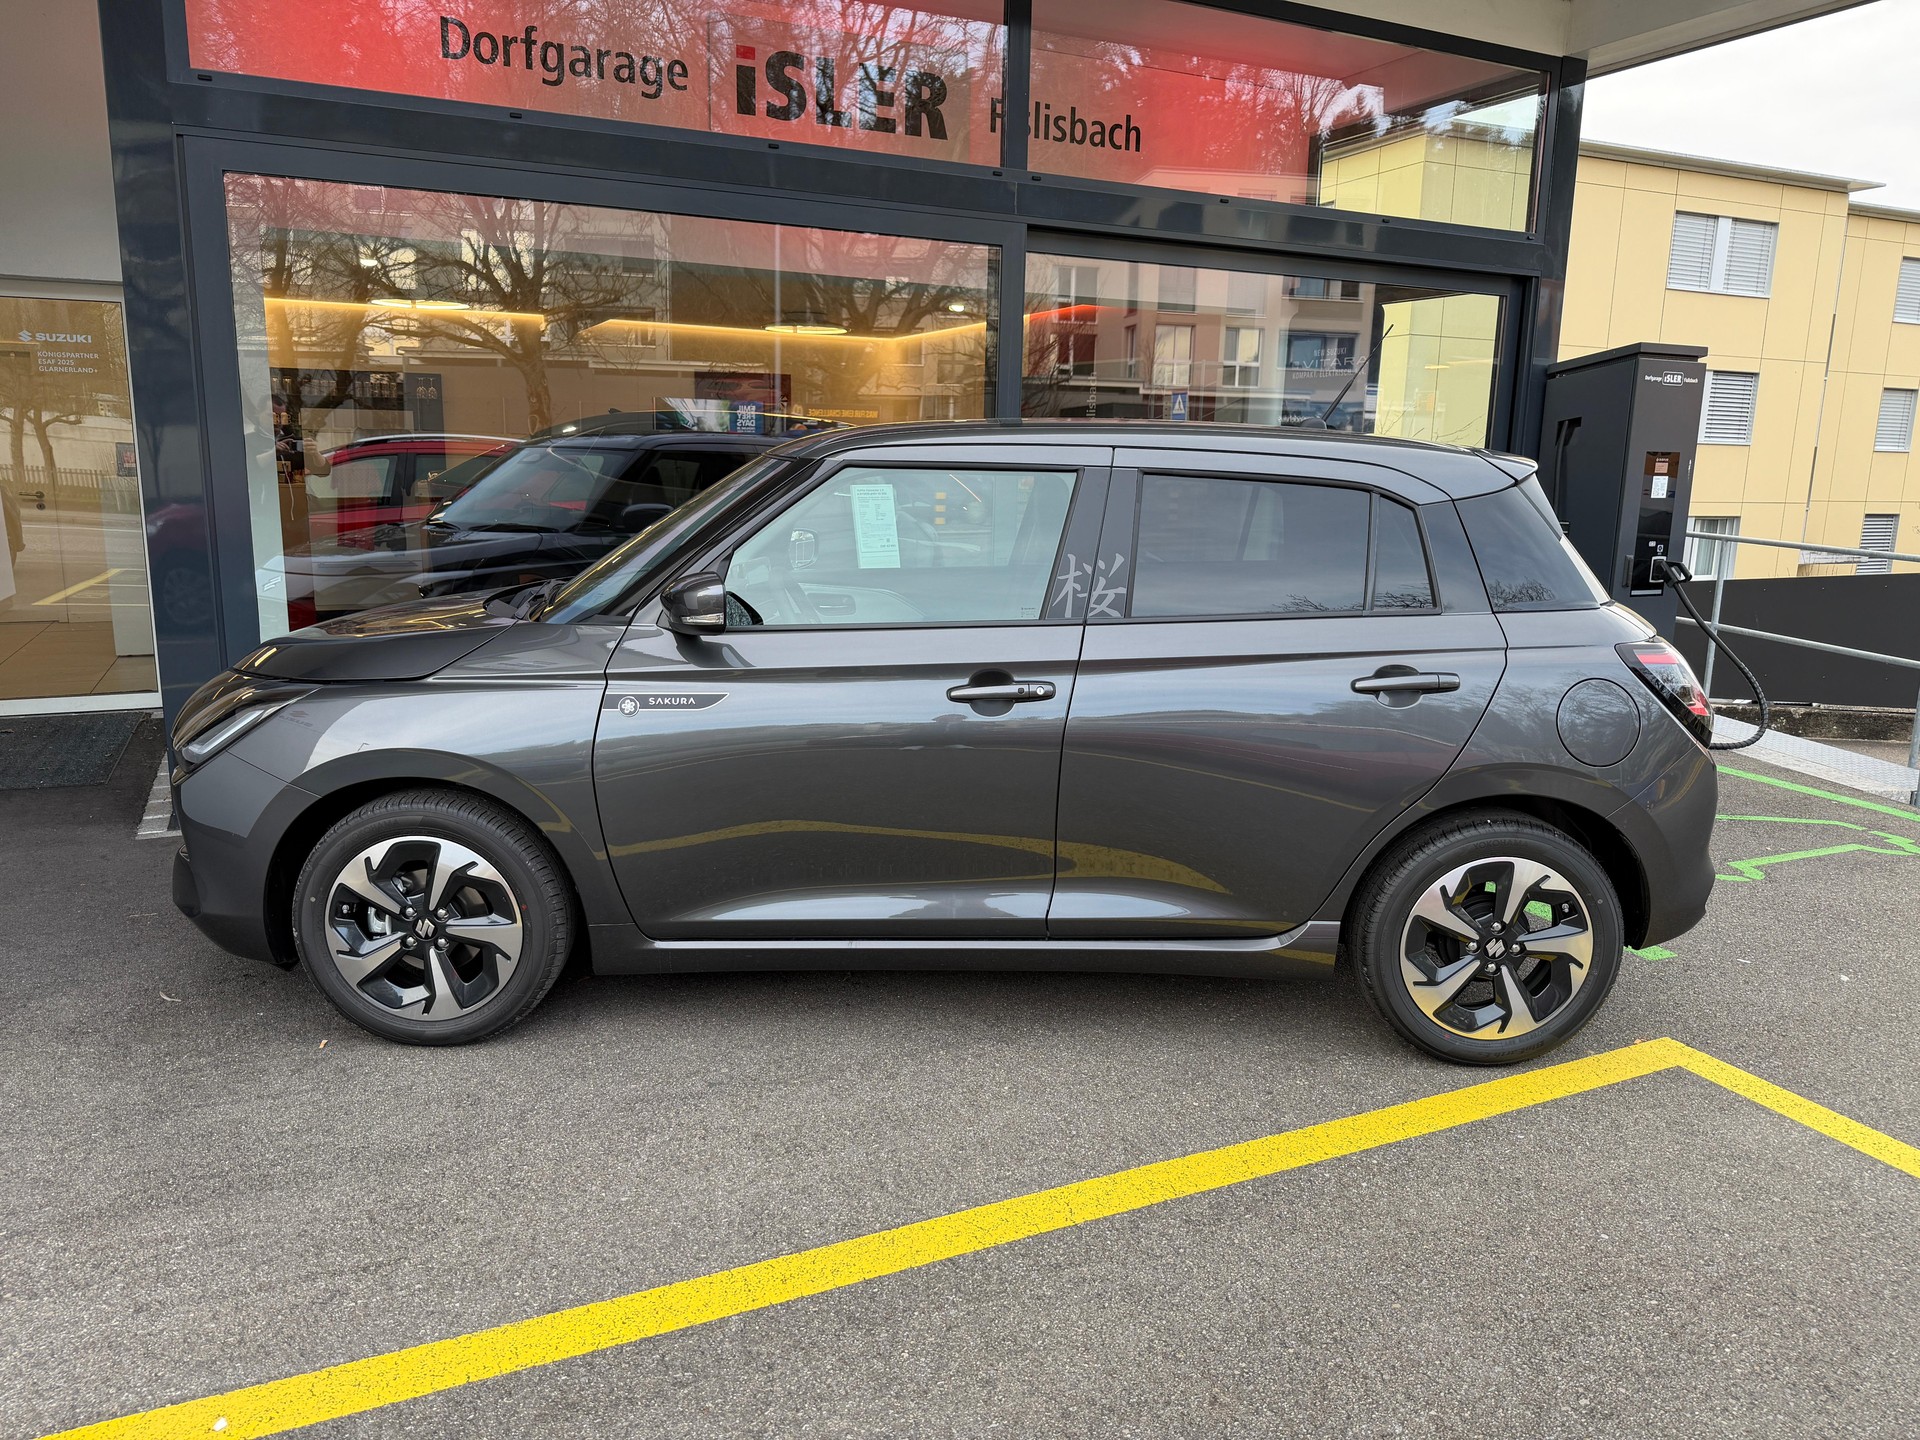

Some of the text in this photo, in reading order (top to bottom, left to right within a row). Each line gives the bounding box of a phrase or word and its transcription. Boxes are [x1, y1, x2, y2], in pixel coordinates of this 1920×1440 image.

[440, 16, 1141, 152] Dorfgarage iSLER Flisbach
[35, 332, 92, 343] SUZUKI
[1326, 347, 1347, 356] SUZUKI
[1052, 553, 1127, 618] 桜
[648, 697, 696, 705] SAKURA
